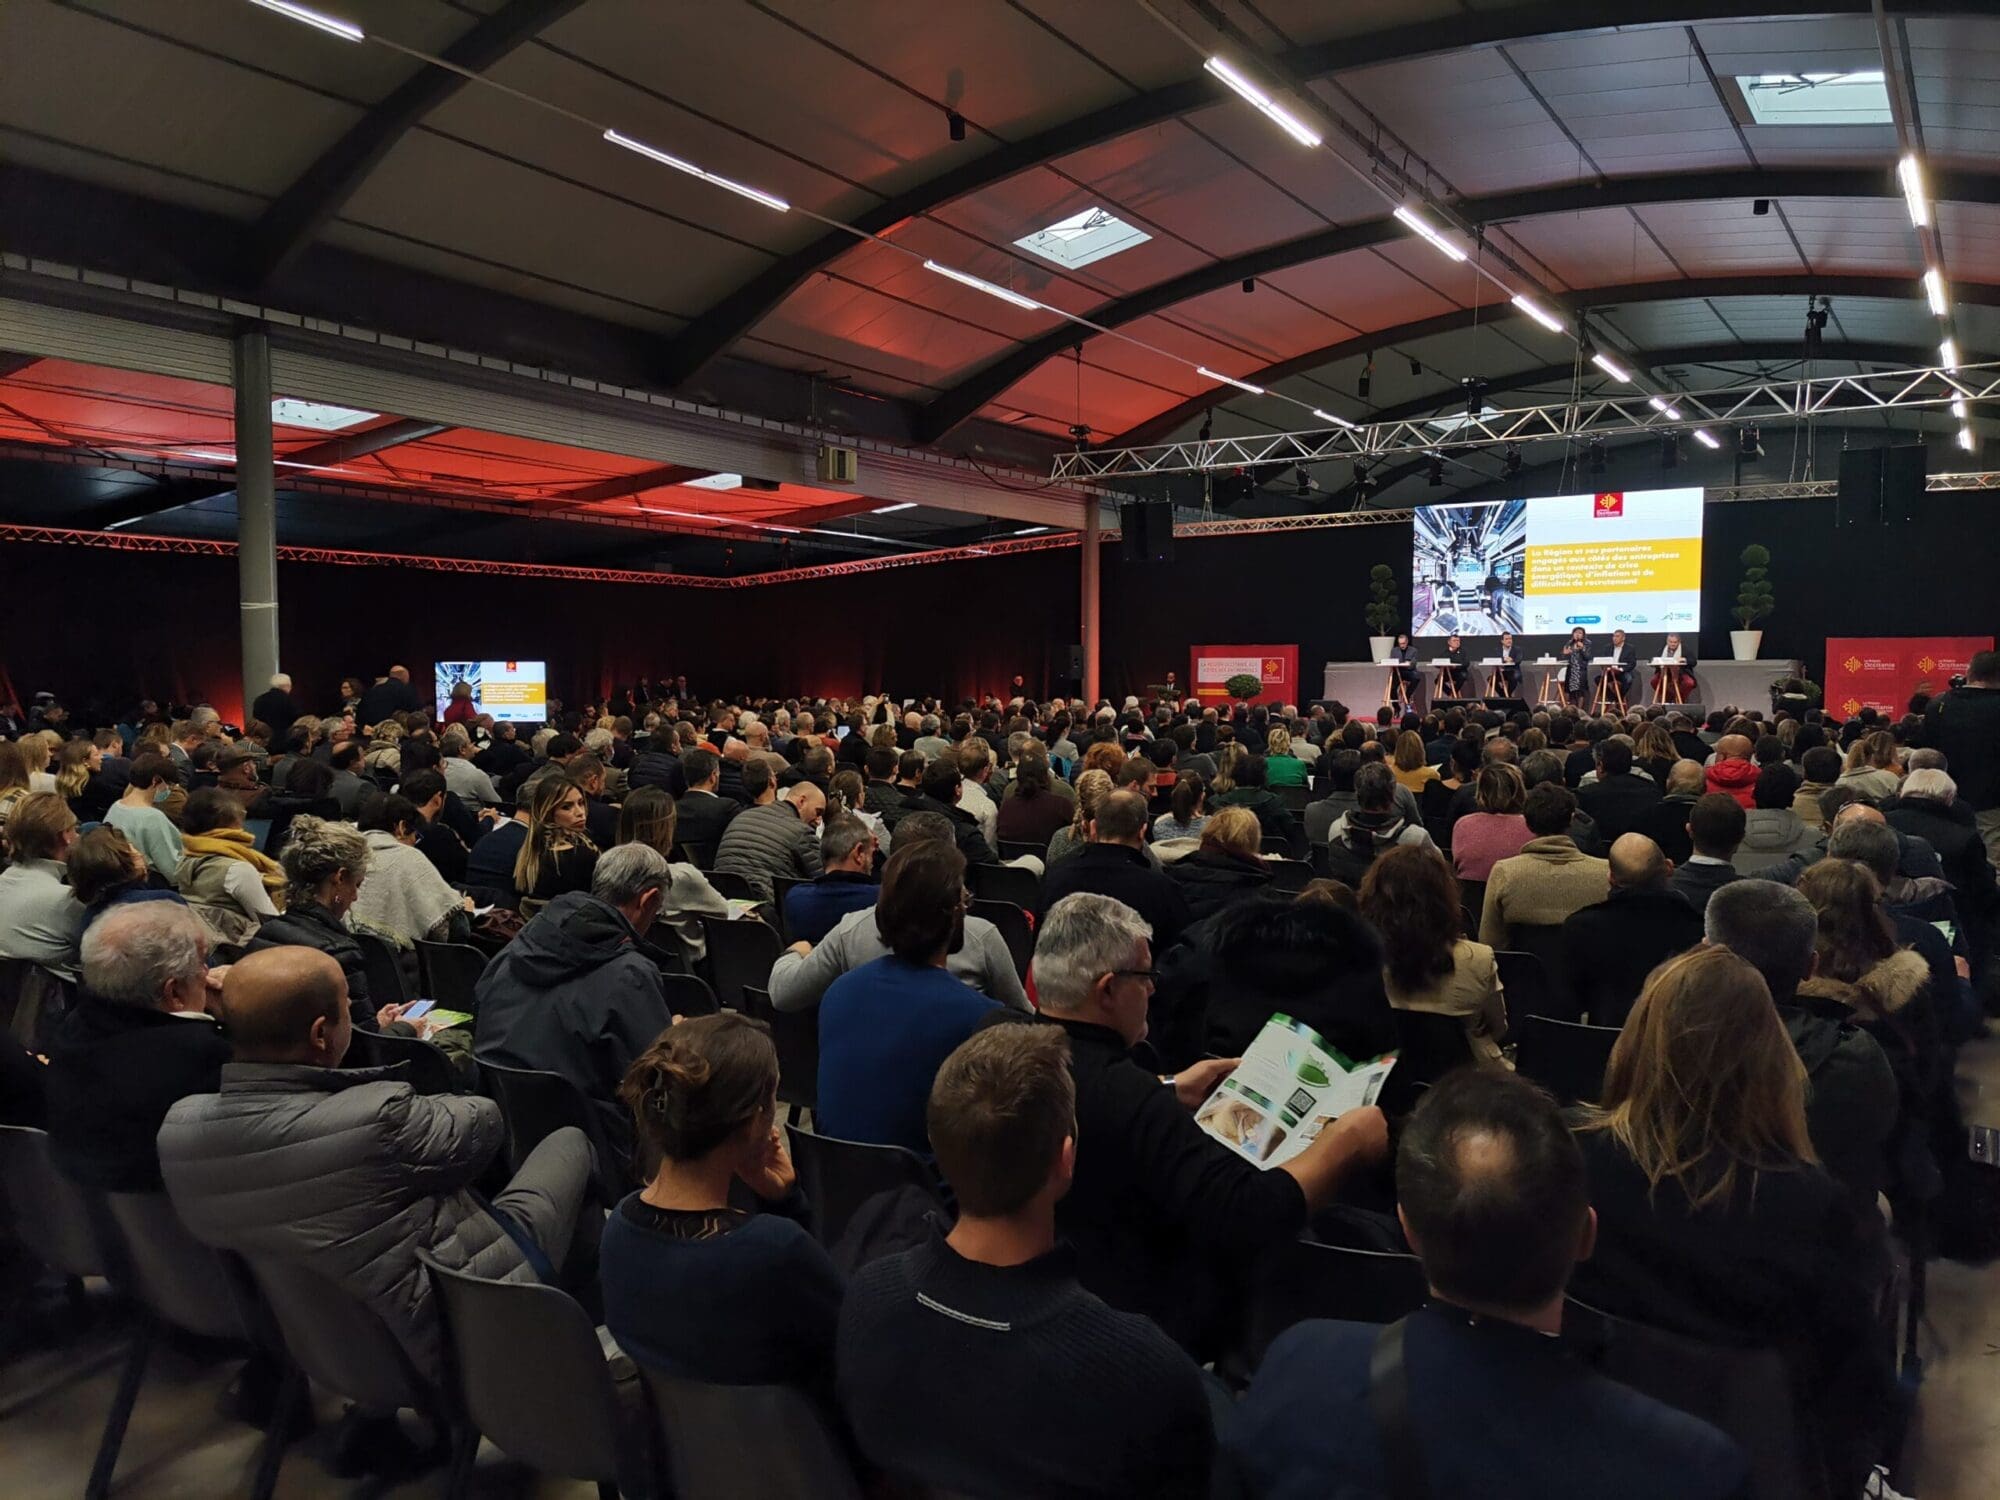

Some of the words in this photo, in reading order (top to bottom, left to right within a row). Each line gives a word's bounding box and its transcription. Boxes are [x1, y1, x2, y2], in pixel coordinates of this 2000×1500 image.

[1543, 549, 1573, 557] Région
[1600, 545, 1652, 555] partenaires
[1629, 552, 1680, 561] entreprises
